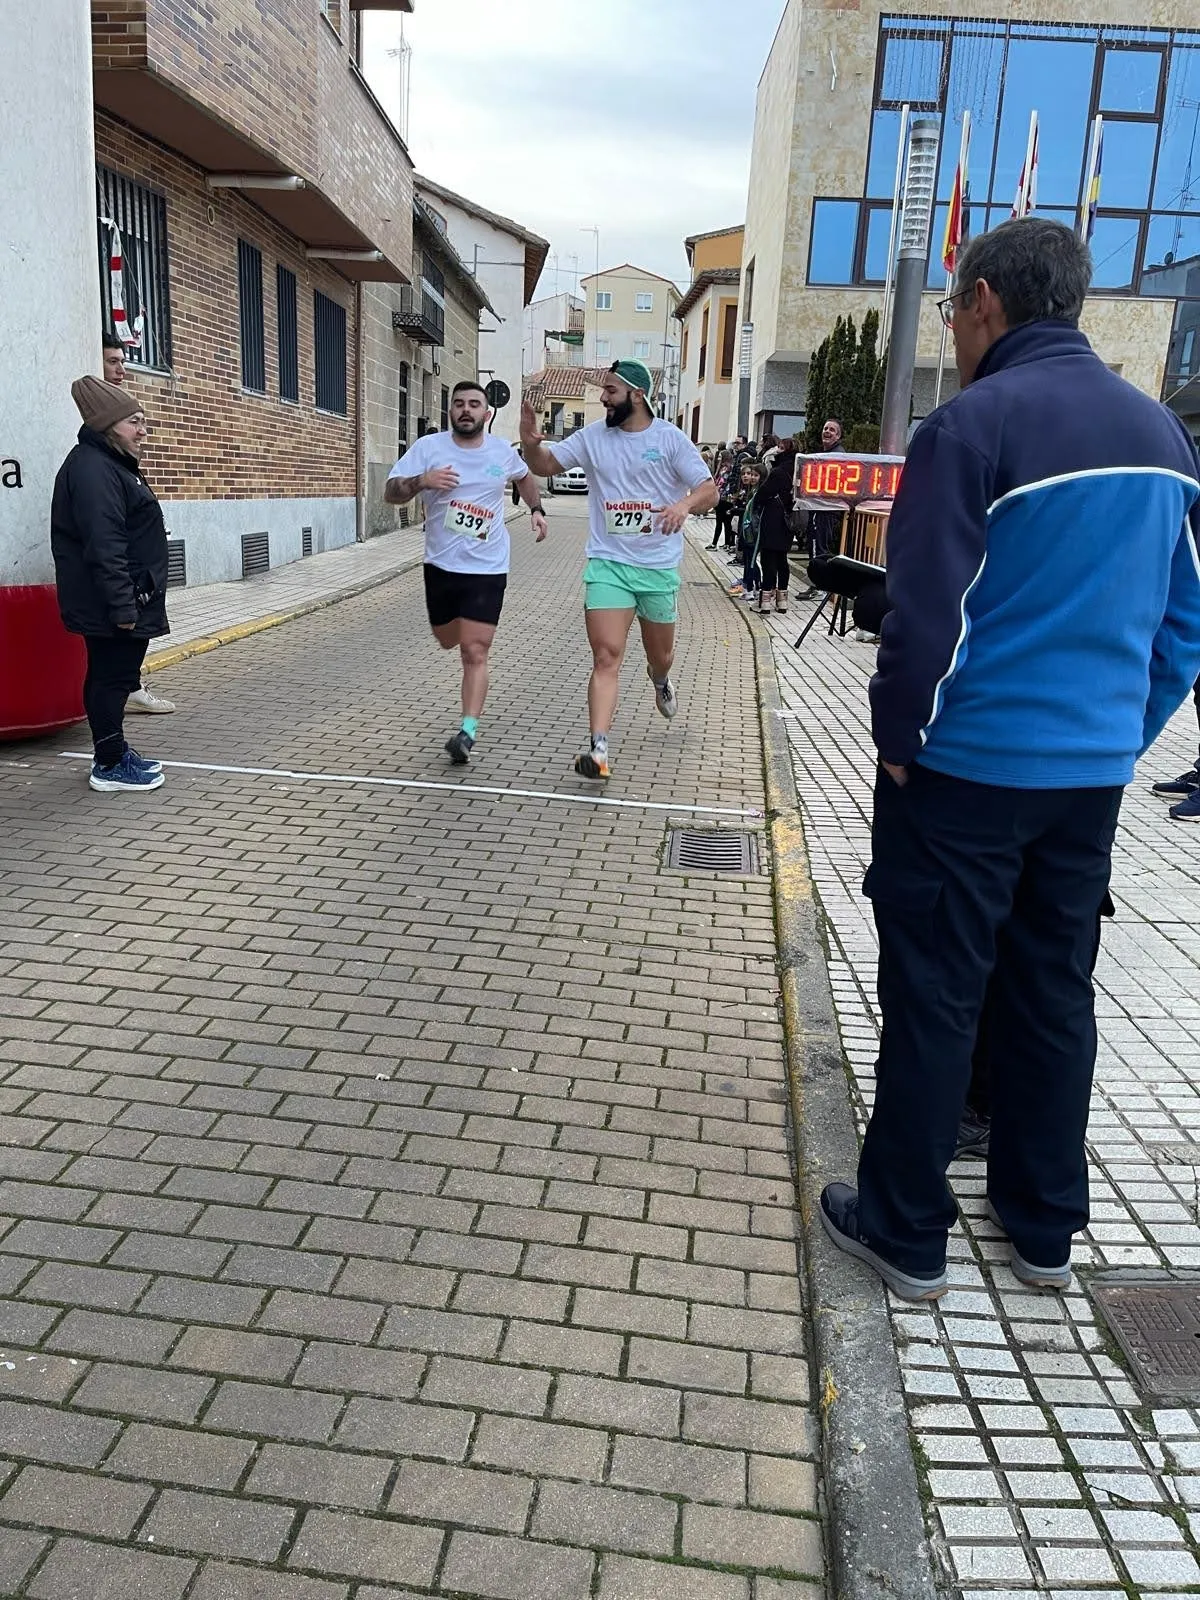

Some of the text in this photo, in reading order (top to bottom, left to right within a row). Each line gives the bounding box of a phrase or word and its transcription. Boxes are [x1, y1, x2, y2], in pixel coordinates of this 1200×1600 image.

[605, 501, 652, 511] bedunia
[455, 512, 484, 531] 339
[614, 512, 643, 527] 279
